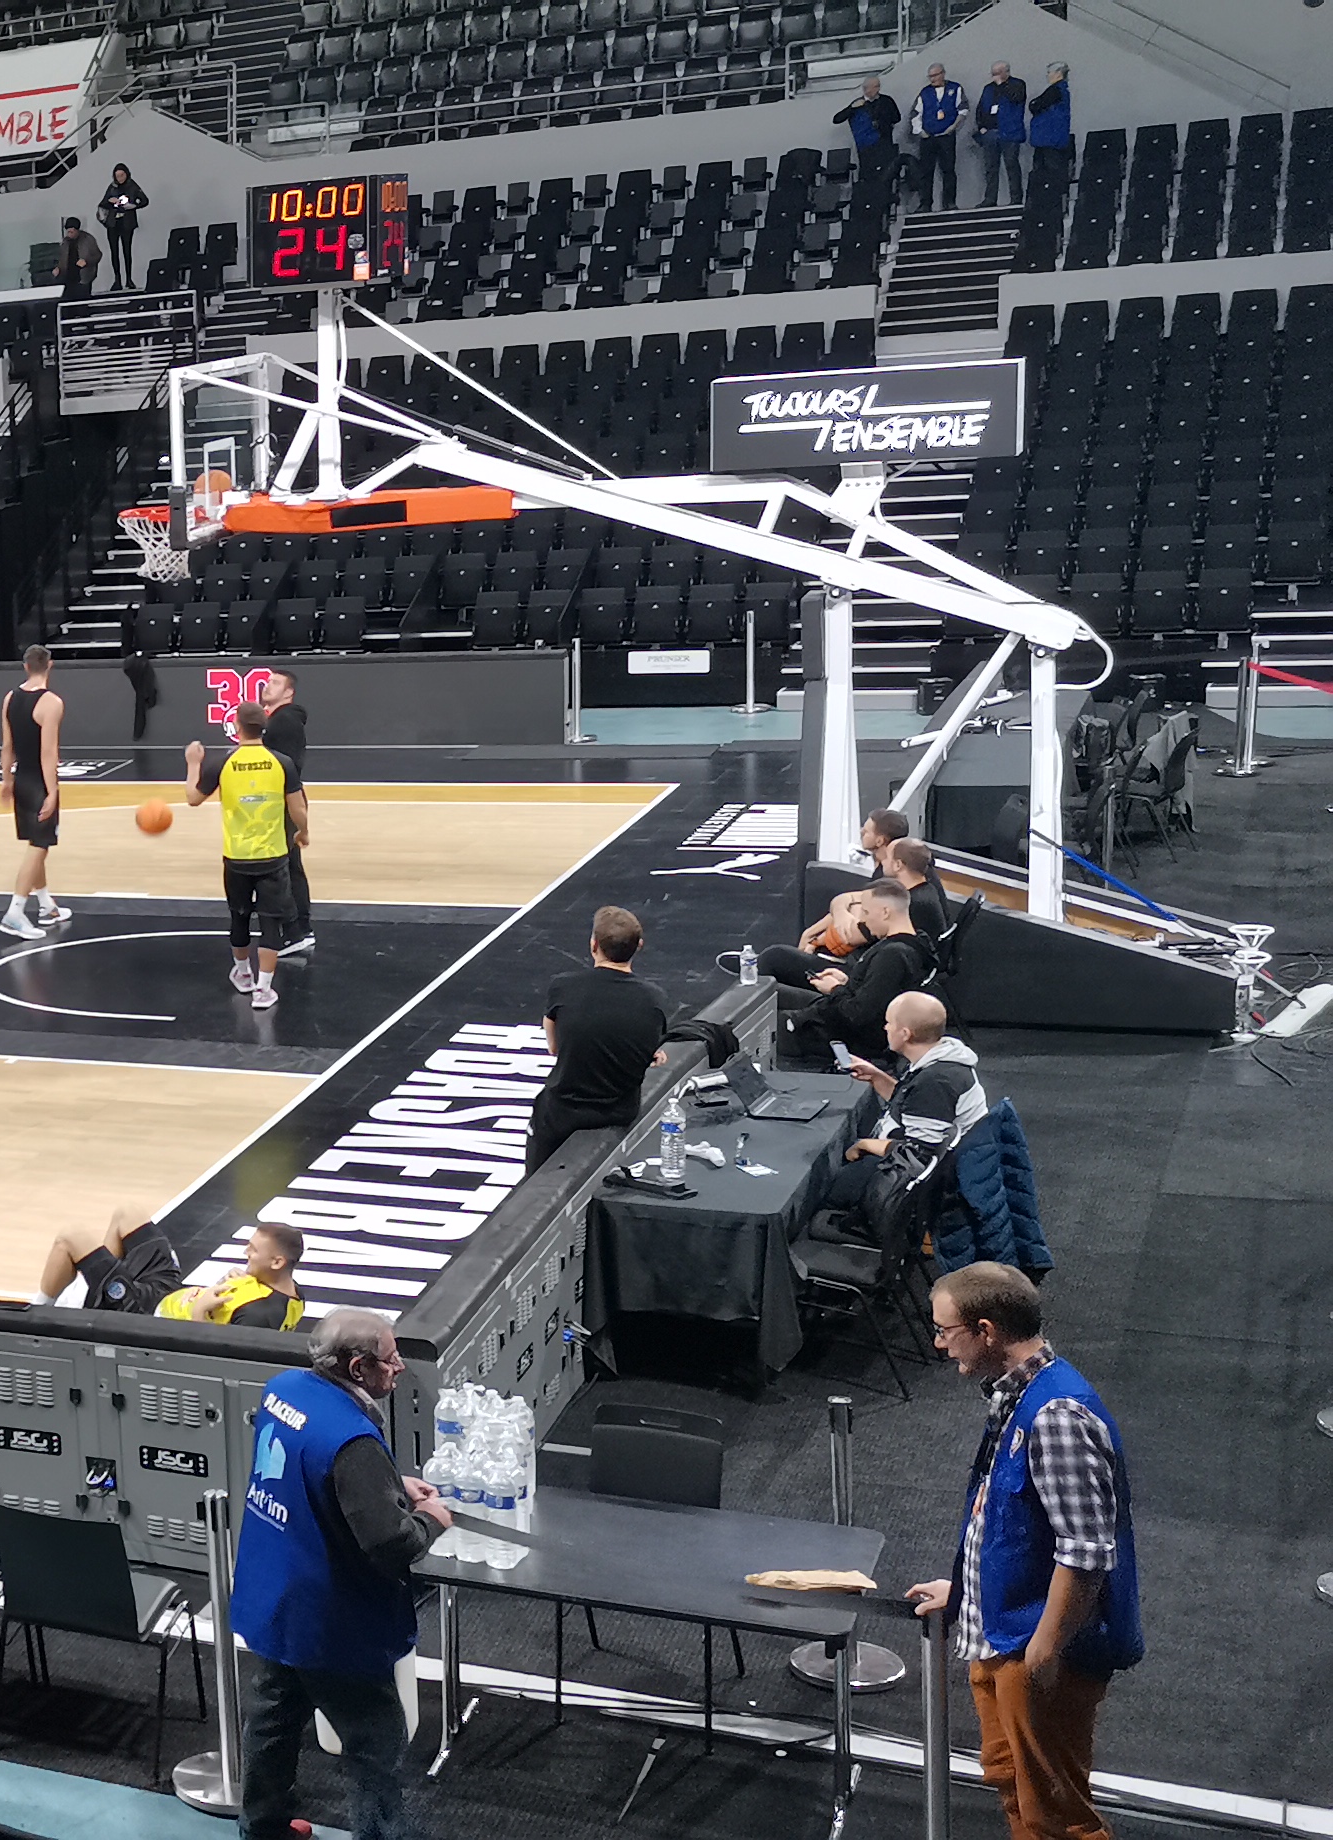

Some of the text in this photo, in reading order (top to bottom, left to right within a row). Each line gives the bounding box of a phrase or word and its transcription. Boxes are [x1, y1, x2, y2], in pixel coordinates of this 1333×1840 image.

[269, 183, 364, 223] 10:00
[271, 225, 348, 277] 24
[382, 220, 405, 267] 24
[832, 413, 990, 454] ENSEMBLE
[263, 1392, 308, 1431] PLACEUR
